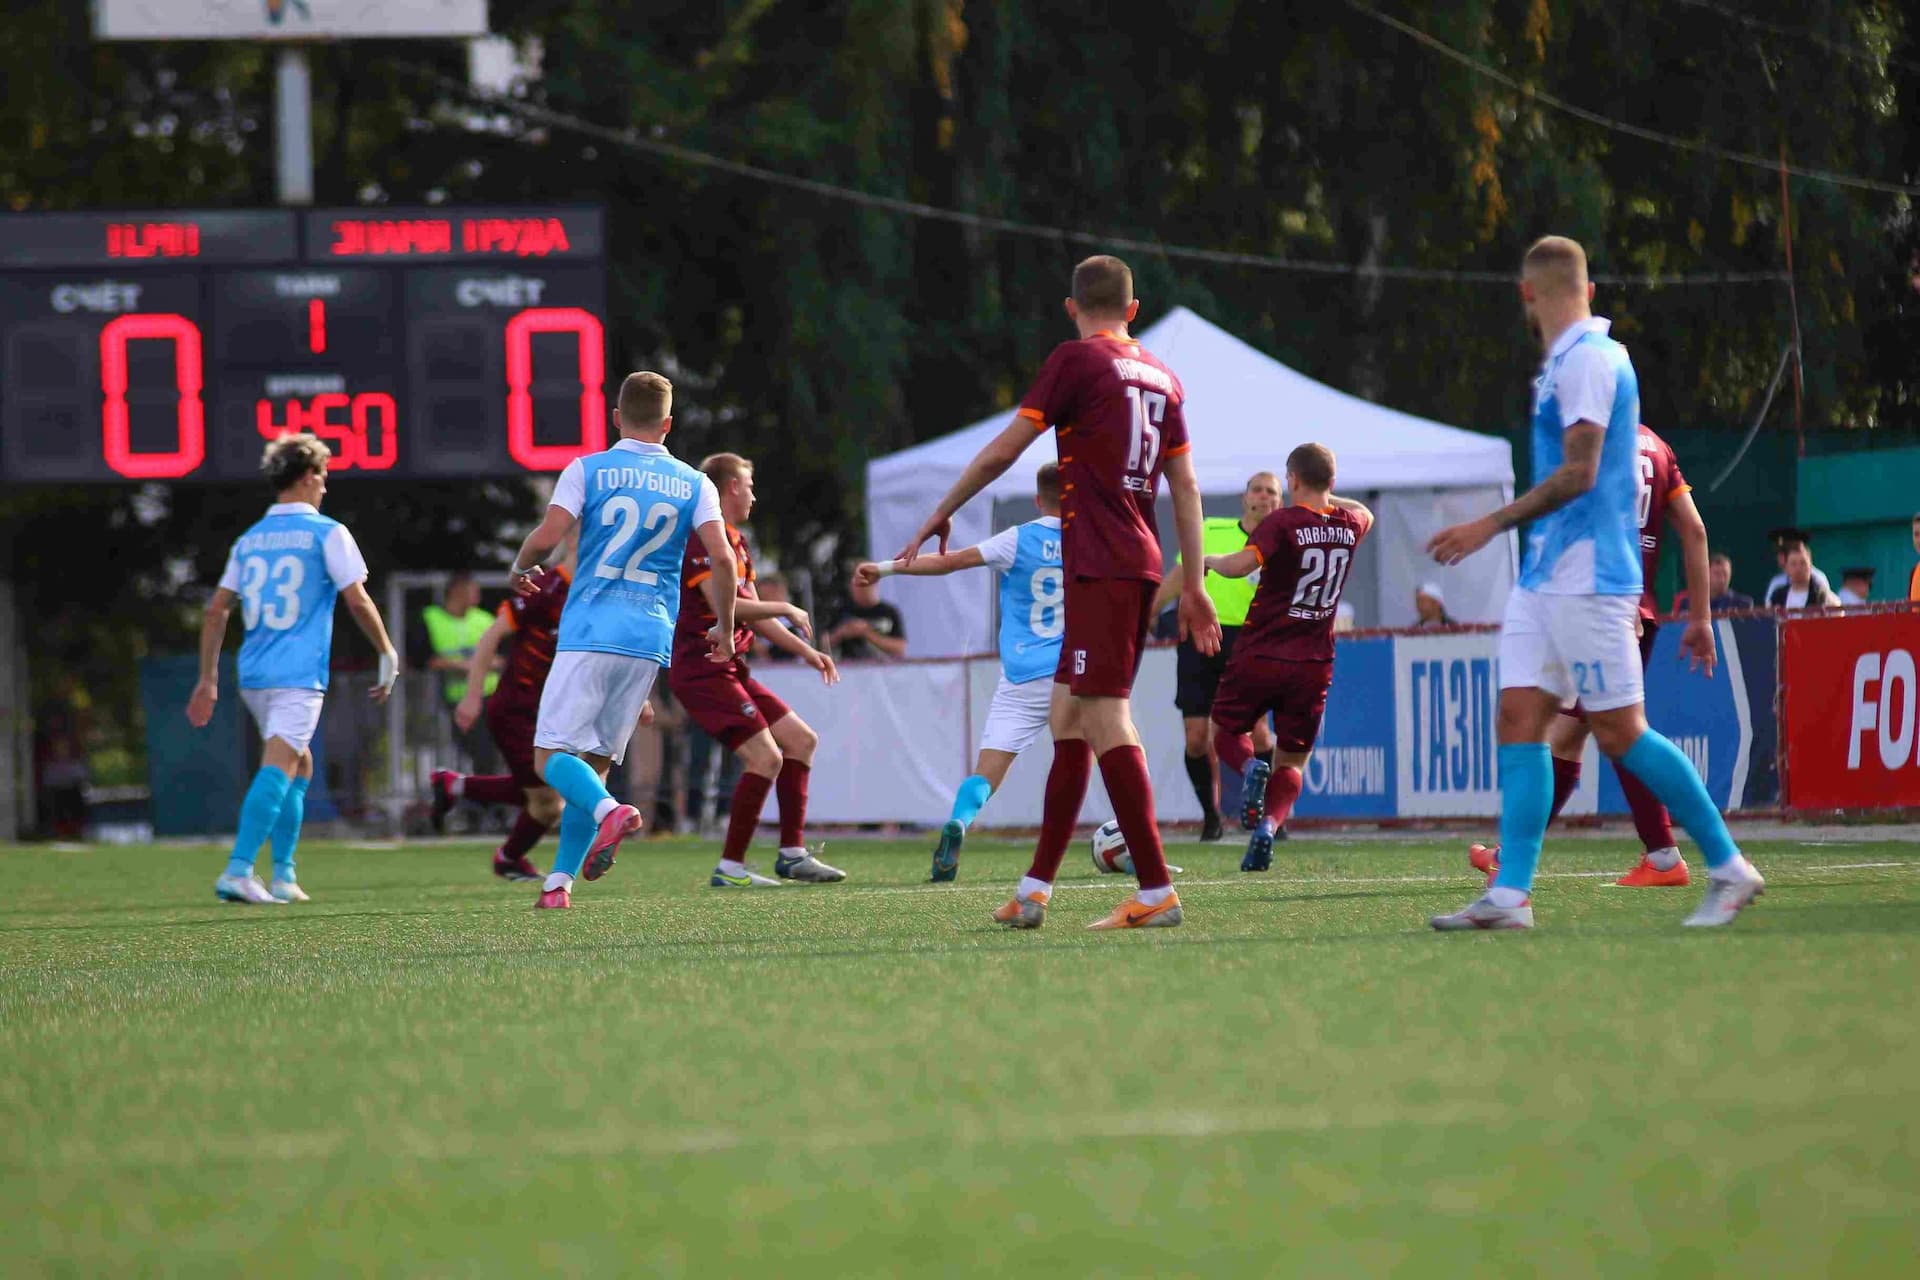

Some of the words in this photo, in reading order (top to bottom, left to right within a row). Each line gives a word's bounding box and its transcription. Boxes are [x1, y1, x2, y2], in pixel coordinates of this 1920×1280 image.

[308, 298, 328, 354] 1
[101, 313, 205, 479] 0
[506, 307, 606, 471] 0
[1126, 385, 1167, 475] 15
[597, 467, 693, 501] ГОЛУБЦОВ
[594, 495, 679, 586] 22
[241, 555, 305, 631] 33
[1030, 567, 1065, 639] 8
[1291, 548, 1350, 608] 20
[1074, 649, 1087, 675] 15
[1573, 661, 1606, 695] 21
[1411, 658, 1501, 793] ГАЗП
[1847, 648, 1920, 770] FO
[1326, 746, 1386, 796] ГАЗПРОМ
